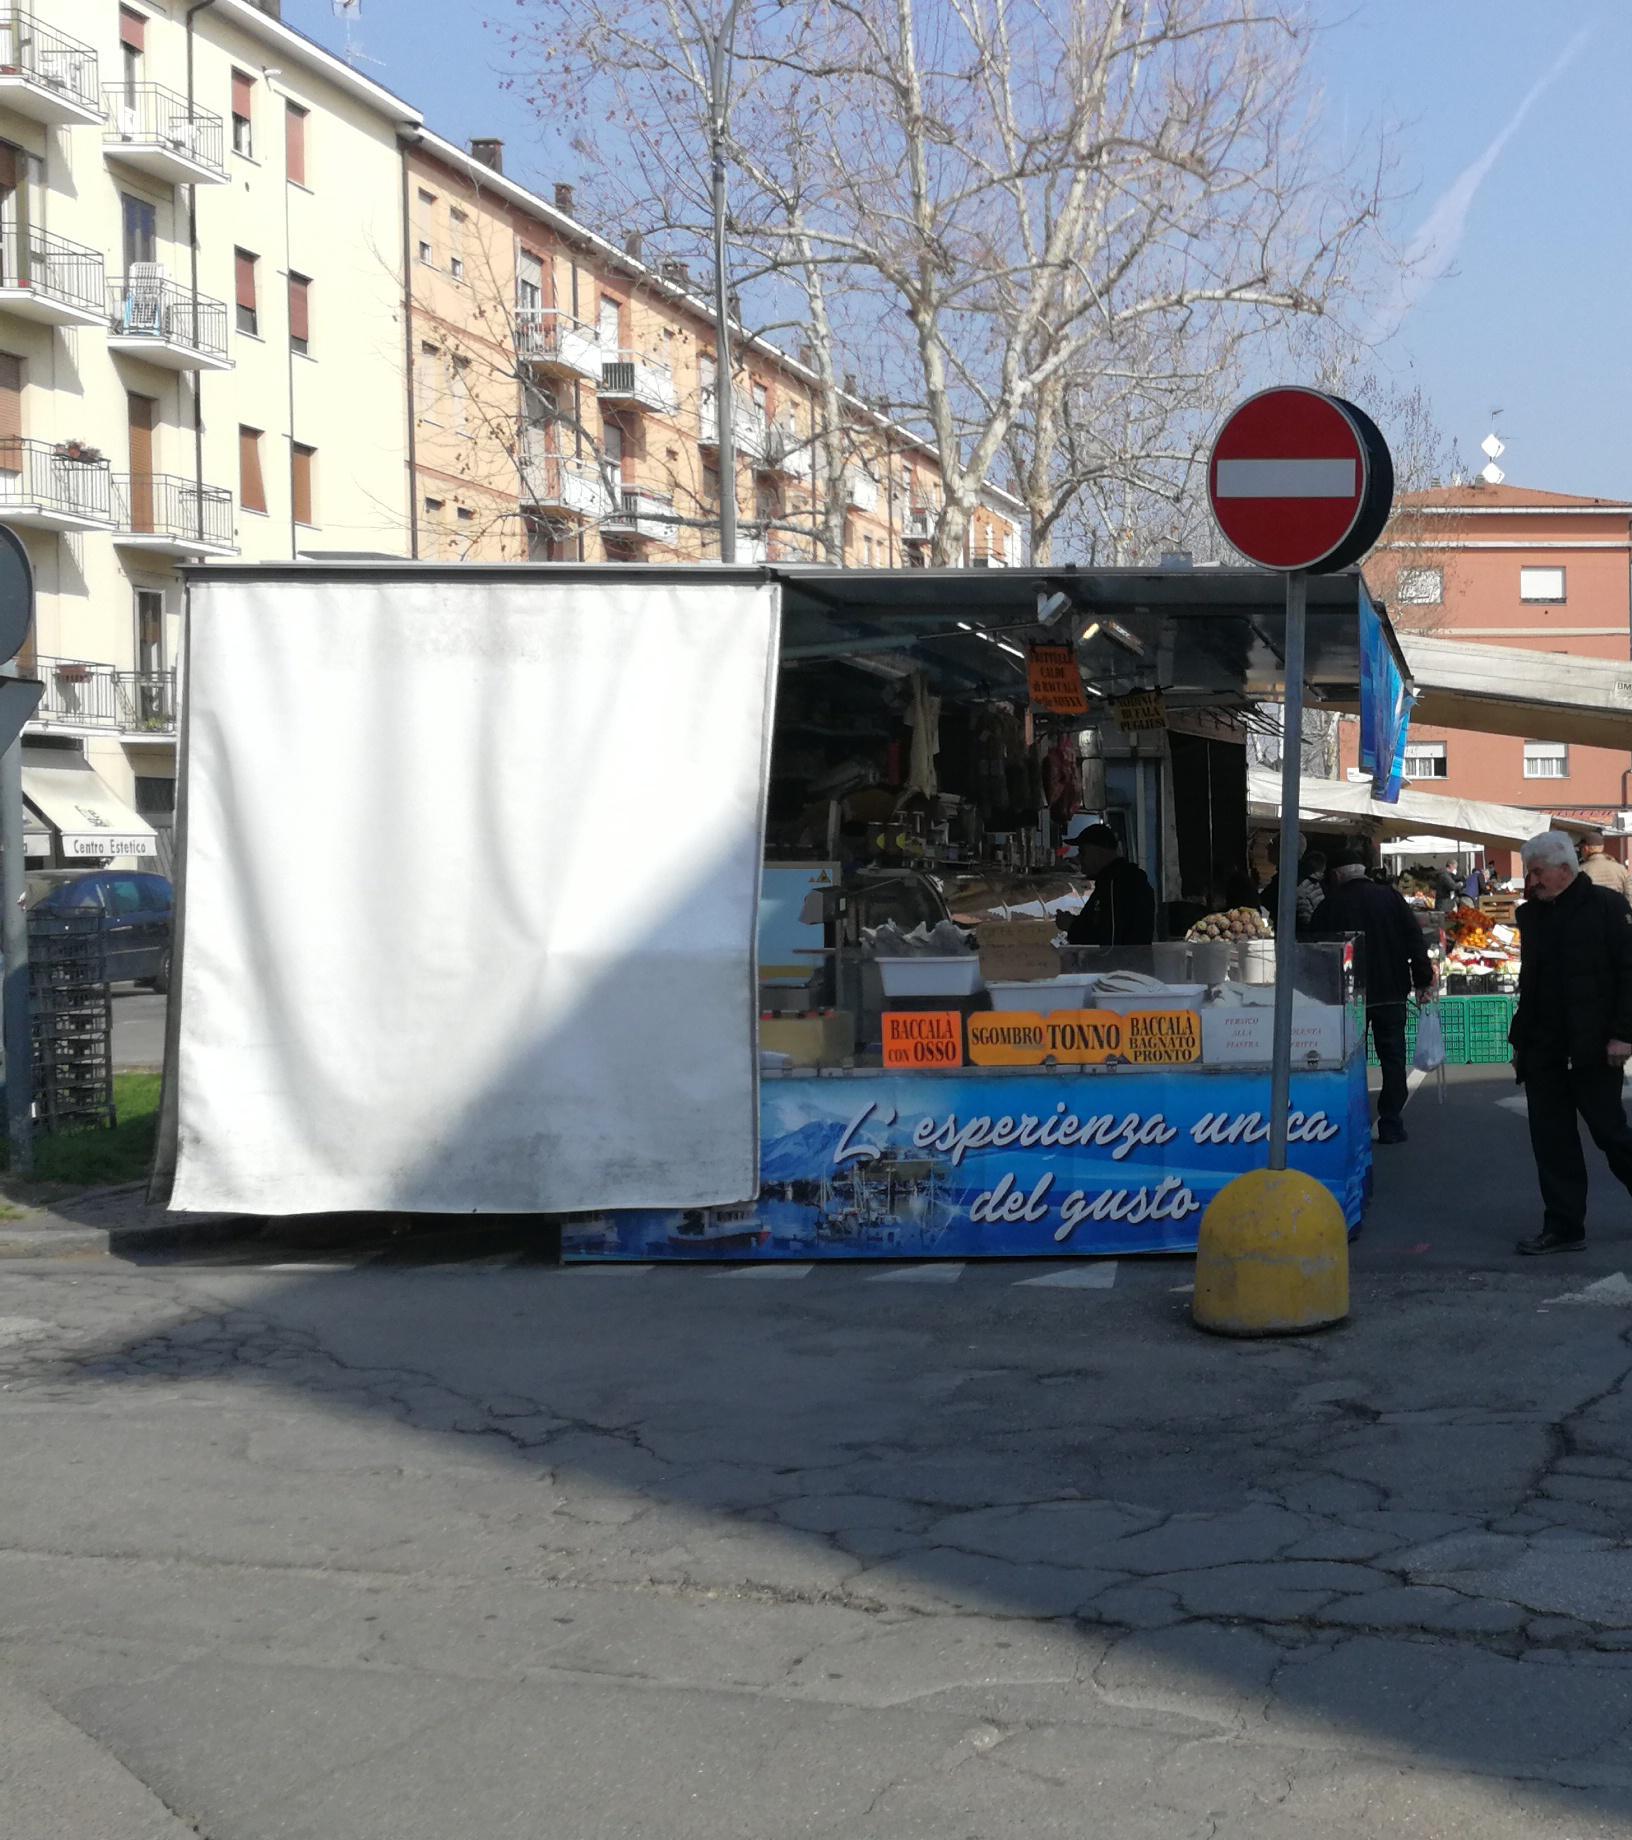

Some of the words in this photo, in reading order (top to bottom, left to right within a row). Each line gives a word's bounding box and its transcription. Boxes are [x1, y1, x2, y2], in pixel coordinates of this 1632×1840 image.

[73, 839, 104, 854] Centro
[110, 839, 146, 854] Estetico
[890, 1011, 953, 1040] BACCALÀ
[1130, 1009, 1194, 1037] BACCALÀ
[971, 1026, 1043, 1046] SGOMBRO
[1046, 1023, 1121, 1050] TONNO
[1128, 1036, 1196, 1049] BAGNATO
[1291, 1041, 1318, 1049] RITTA
[888, 1049, 910, 1062] CON
[914, 1041, 957, 1062] OSSO
[1134, 1049, 1192, 1062] PRONTO
[912, 1101, 1178, 1166] esperienza
[1190, 1099, 1339, 1144] unca
[969, 1172, 1055, 1223] del
[1054, 1176, 1200, 1242] gusto
